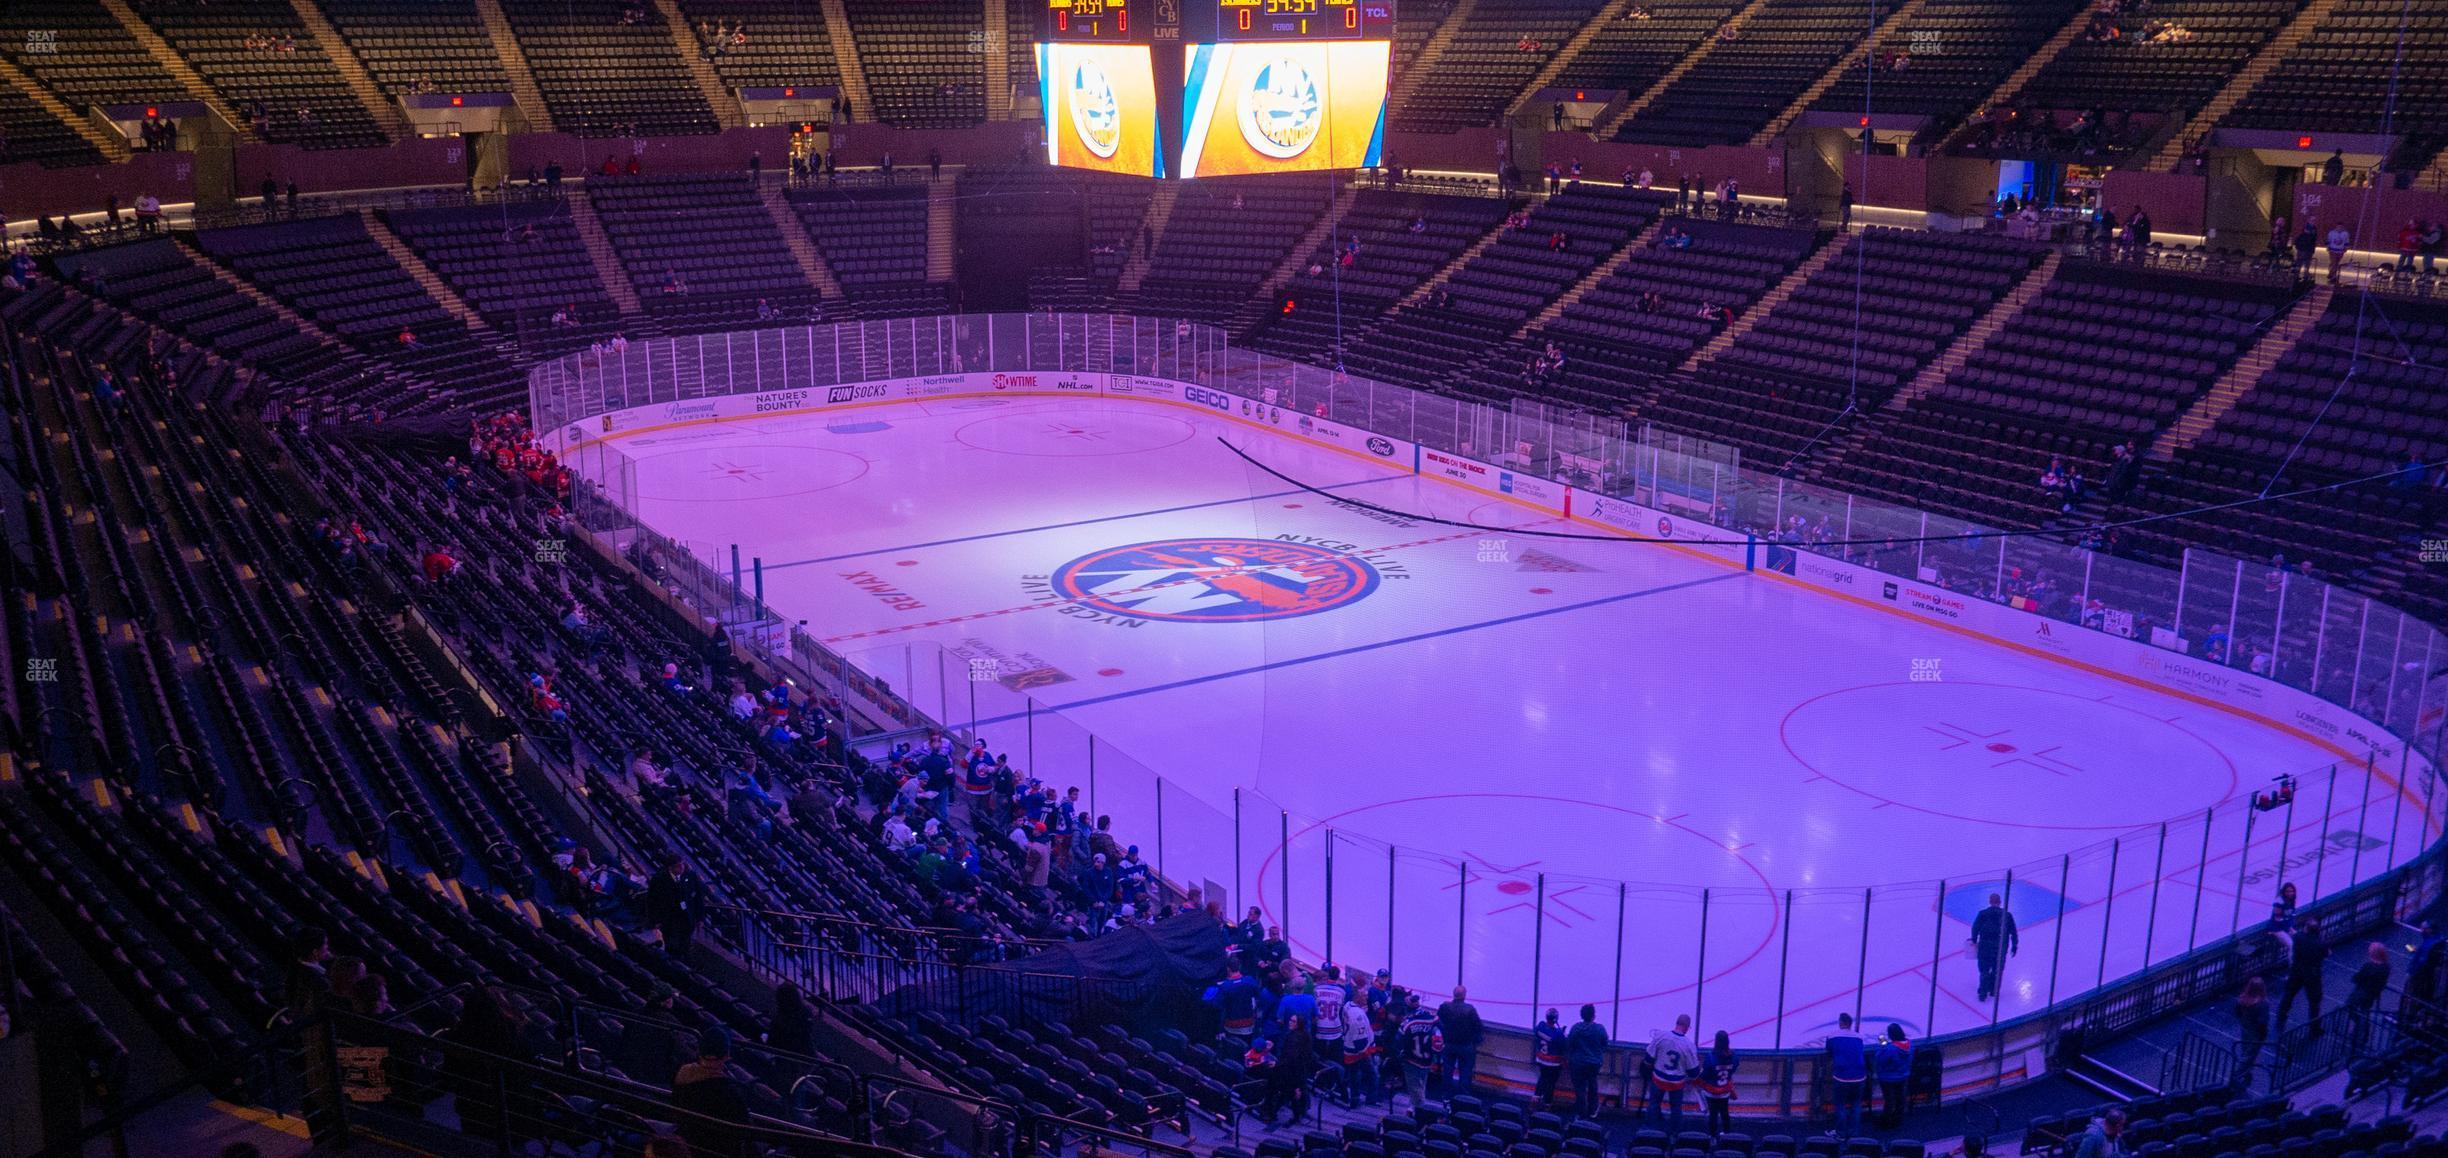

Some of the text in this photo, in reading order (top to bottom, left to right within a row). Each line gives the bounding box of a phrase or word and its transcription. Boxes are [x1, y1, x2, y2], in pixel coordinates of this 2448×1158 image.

[1366, 8, 1388, 17] TCL
[1154, 28, 1179, 38] LIVE
[923, 375, 965, 385] Northwell
[756, 390, 808, 403] NATURE'S
[829, 384, 888, 402] FUN SOCKS
[1185, 386, 1230, 411] GEICO
[756, 400, 801, 412] BOUNTY
[1370, 438, 1391, 455] Ford
[1275, 533, 1360, 552] NYCB
[1364, 554, 1411, 581] LIVE
[840, 570, 927, 612] RE/MAX
[1021, 573, 1052, 602] LIVE
[1912, 600, 1925, 609] LIVE
[1057, 606, 1148, 629] NYCB
[2164, 662, 2230, 688] HARMONY
[1317, 999, 1339, 1021] 30
[1663, 1049, 1682, 1071] 3
